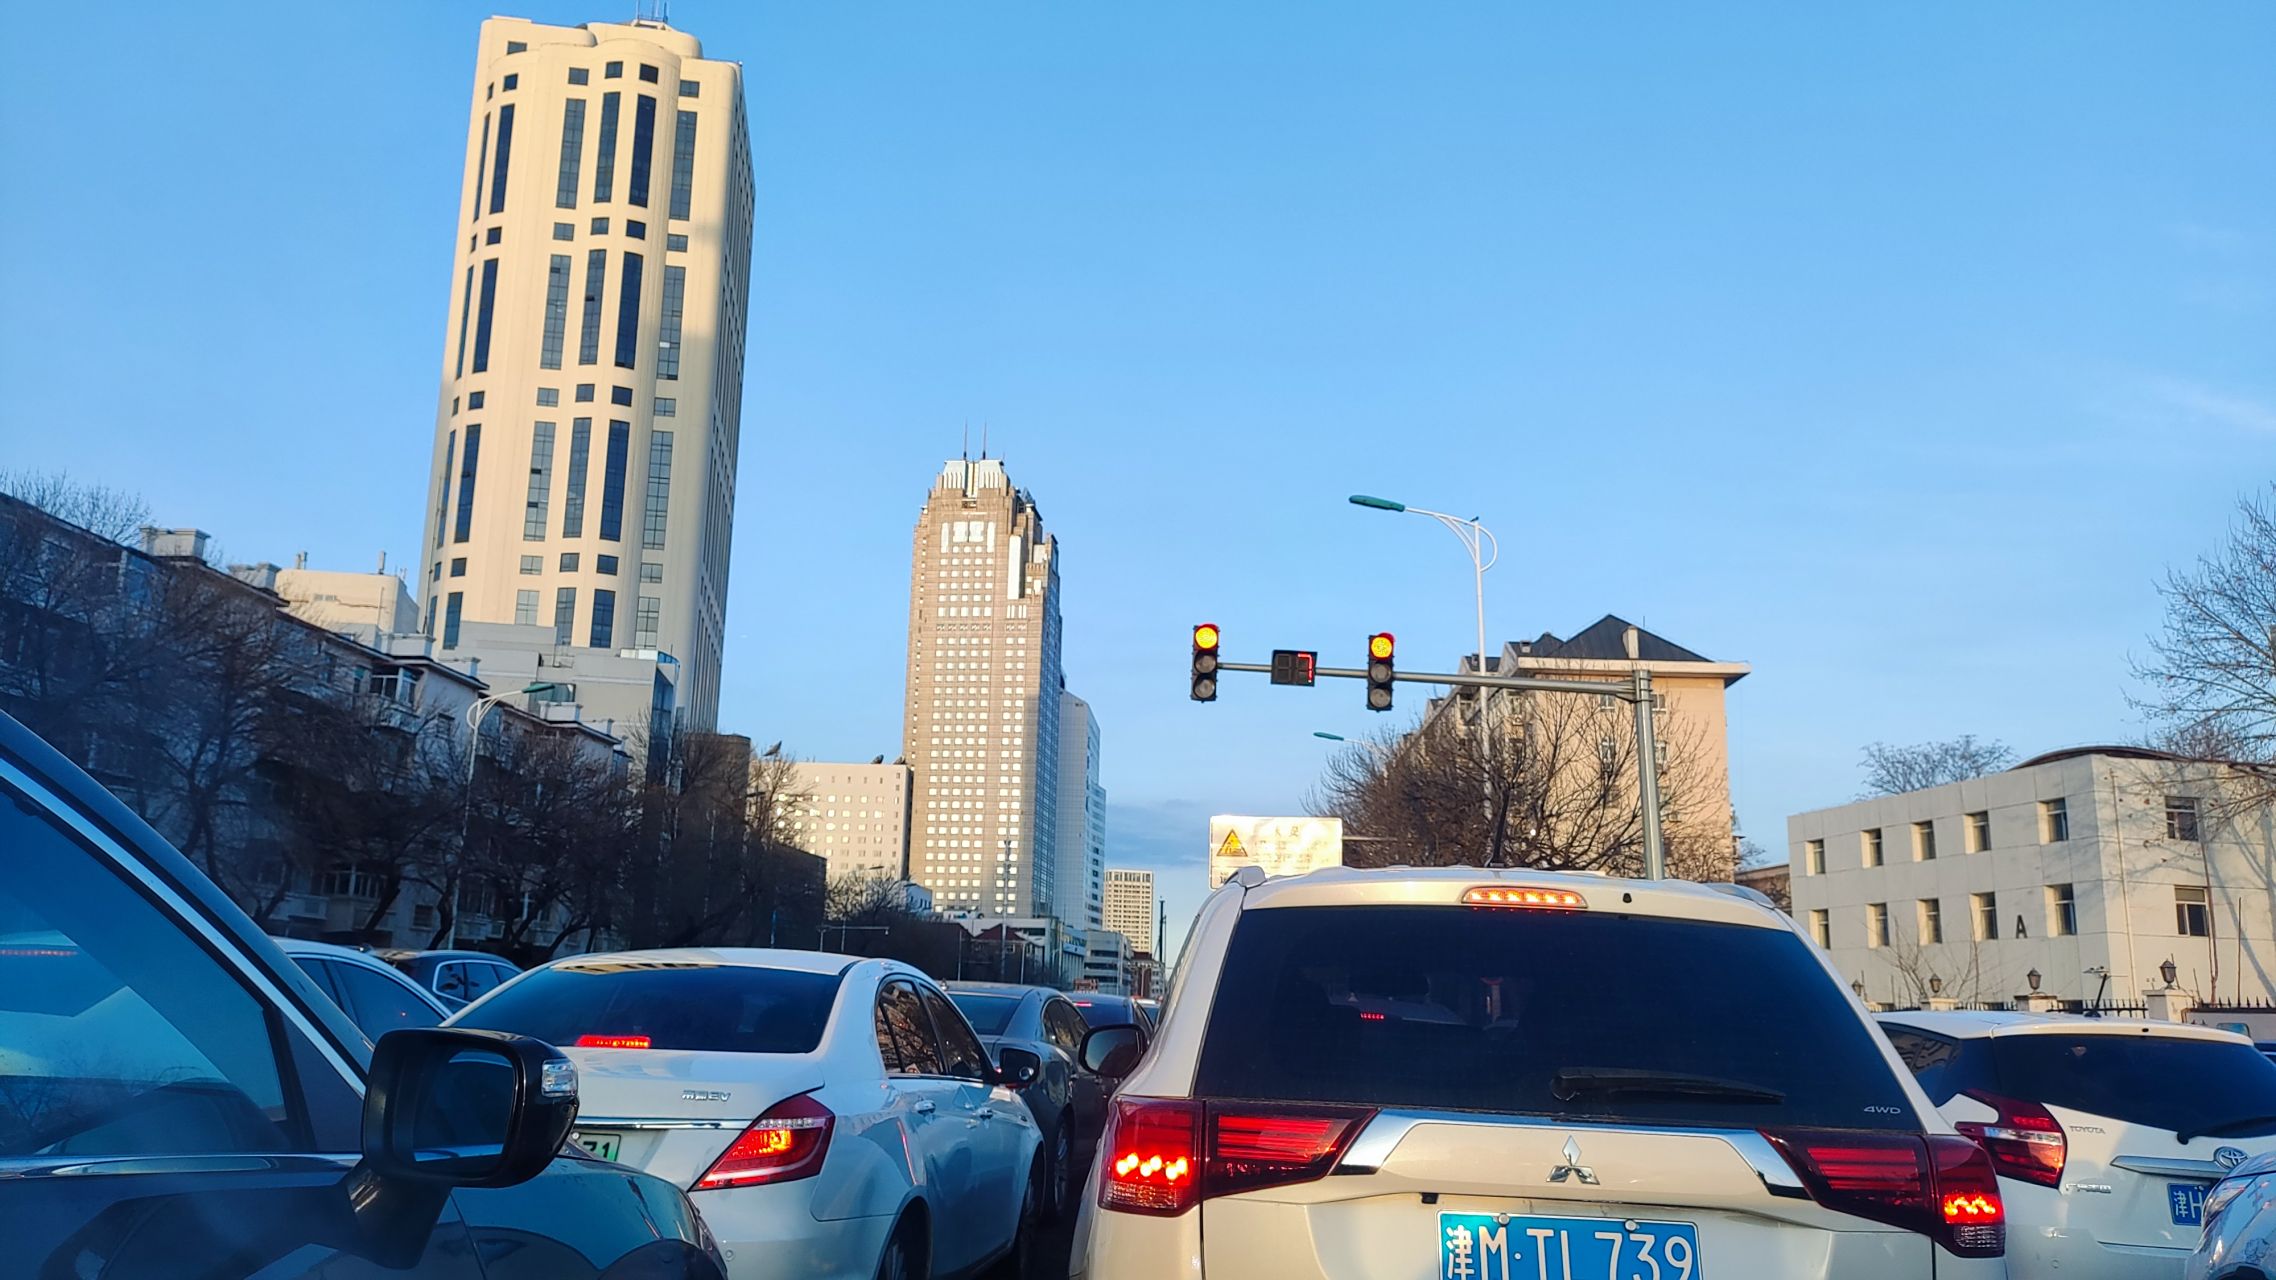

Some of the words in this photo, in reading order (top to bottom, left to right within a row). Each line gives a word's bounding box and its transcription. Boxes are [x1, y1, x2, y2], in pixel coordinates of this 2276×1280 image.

[2015, 914, 2028, 939] A
[1863, 1105, 1901, 1114] 4WD
[2069, 1125, 2106, 1134] TOYOTA
